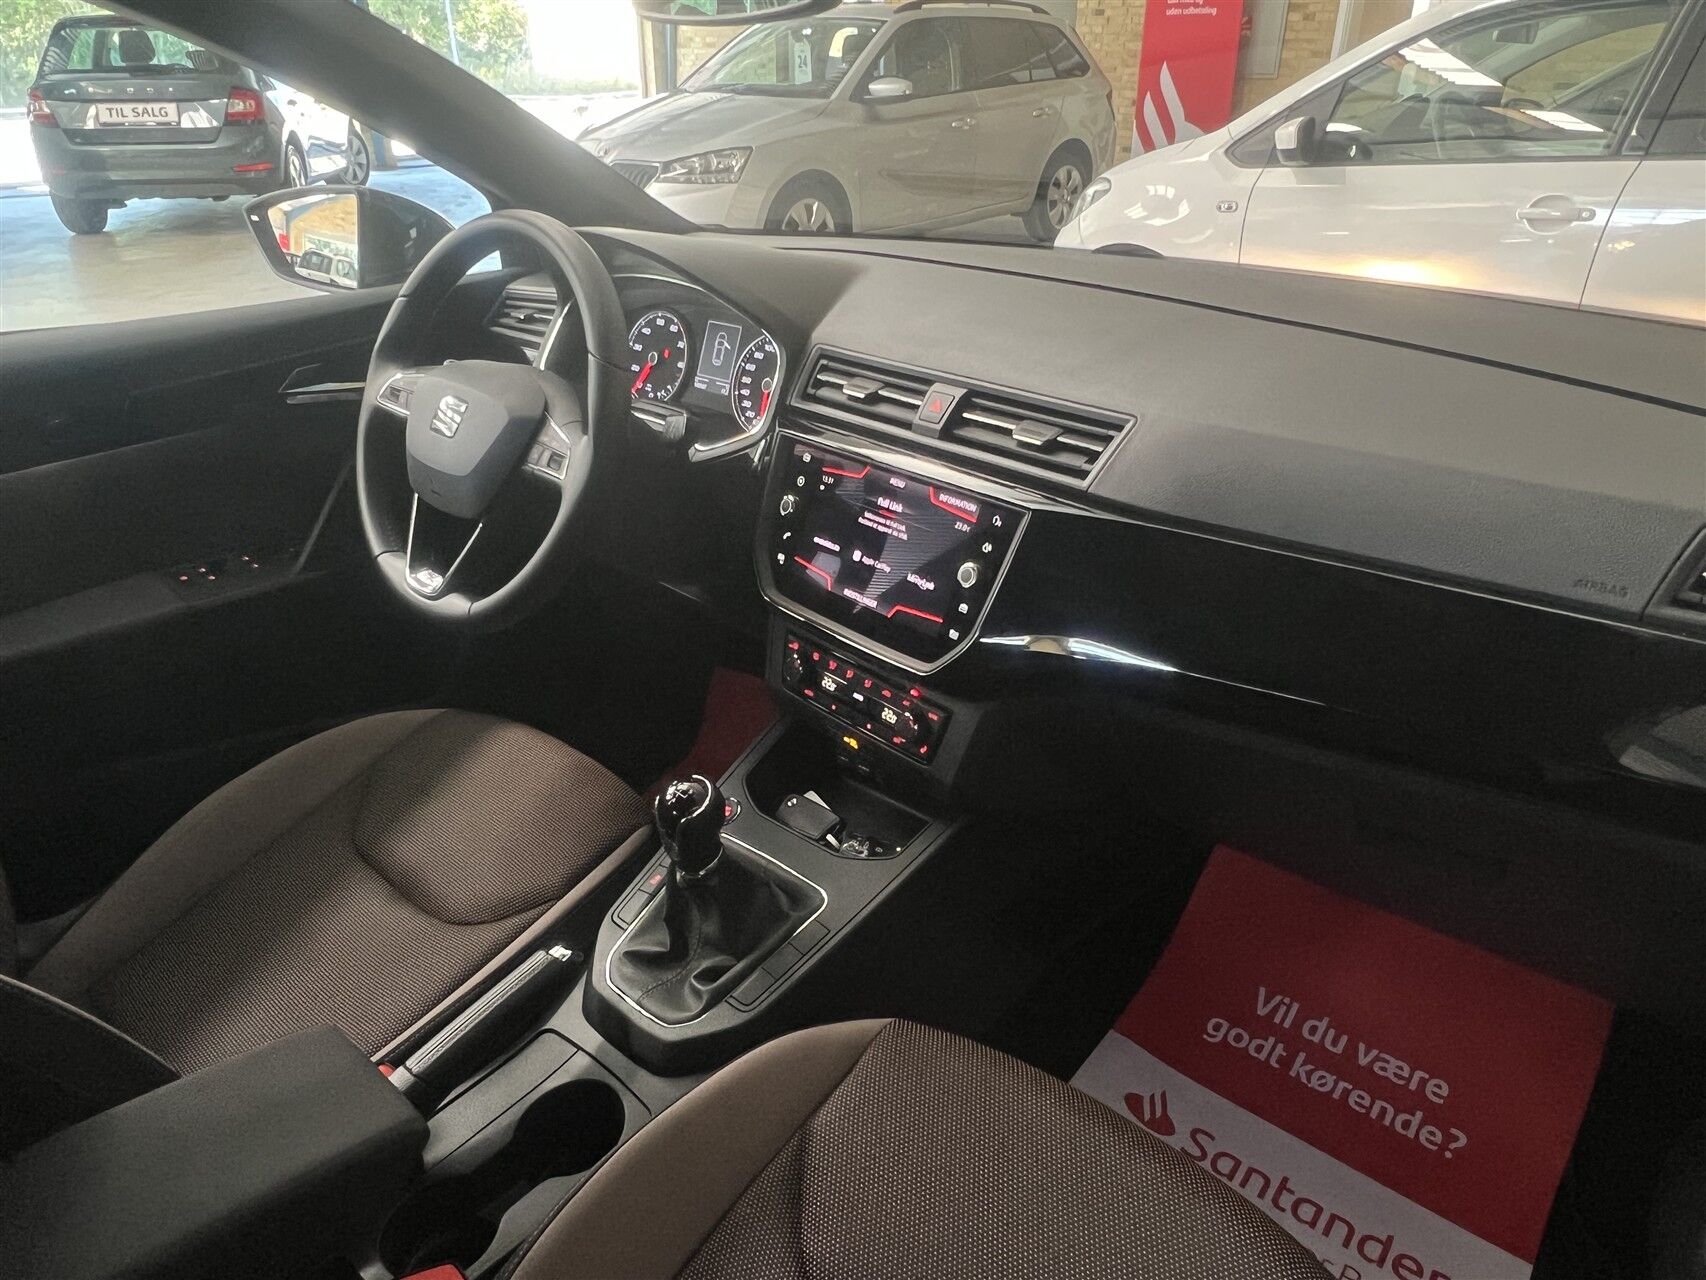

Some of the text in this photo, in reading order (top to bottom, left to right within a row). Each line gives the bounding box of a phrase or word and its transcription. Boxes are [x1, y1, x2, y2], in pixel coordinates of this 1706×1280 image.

[798, 54, 808, 69] 24
[106, 106, 169, 118] TIL SALG
[1256, 986, 1450, 1105] Vil du være
[1202, 1017, 1468, 1160] godt kørende?
